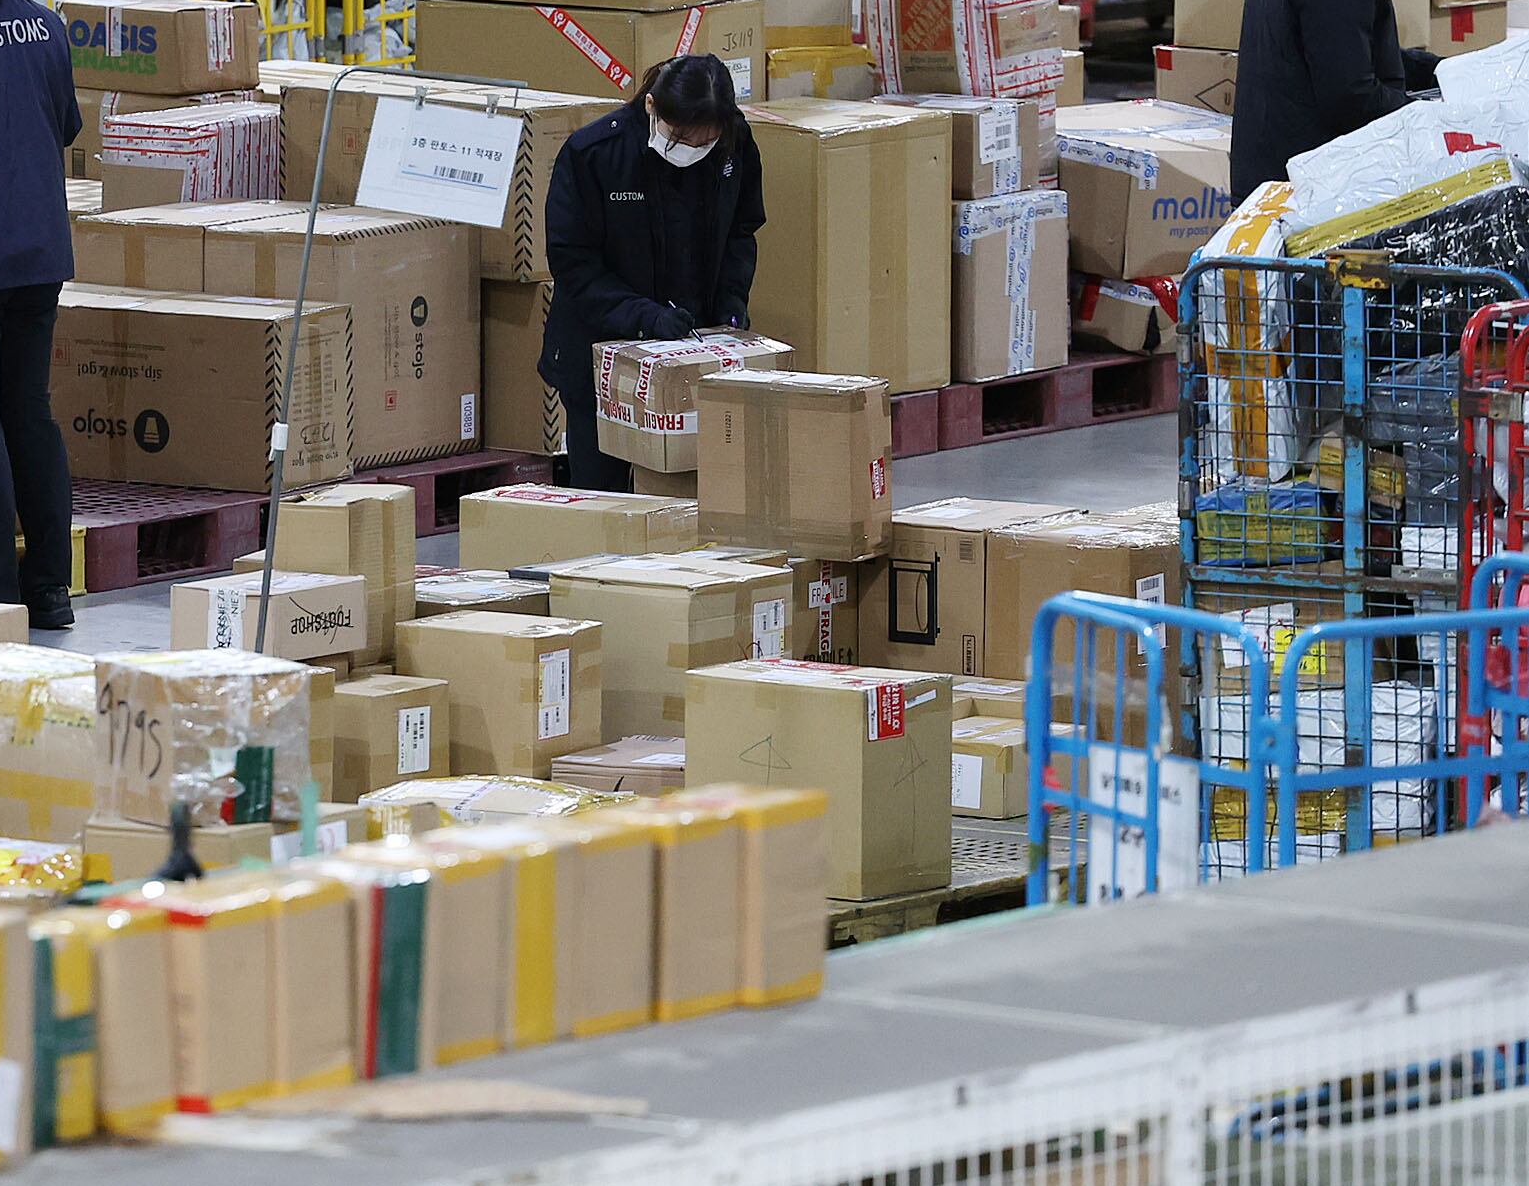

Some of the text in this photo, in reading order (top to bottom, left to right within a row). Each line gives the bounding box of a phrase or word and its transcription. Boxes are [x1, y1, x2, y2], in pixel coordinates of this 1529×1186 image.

[411, 137, 503, 162] 3층 판토스 11 적재장
[412, 332, 425, 380] stojo
[73, 408, 128, 439] stojo
[463, 401, 473, 434] 103889
[291, 609, 352, 635] FOOTSHOP
